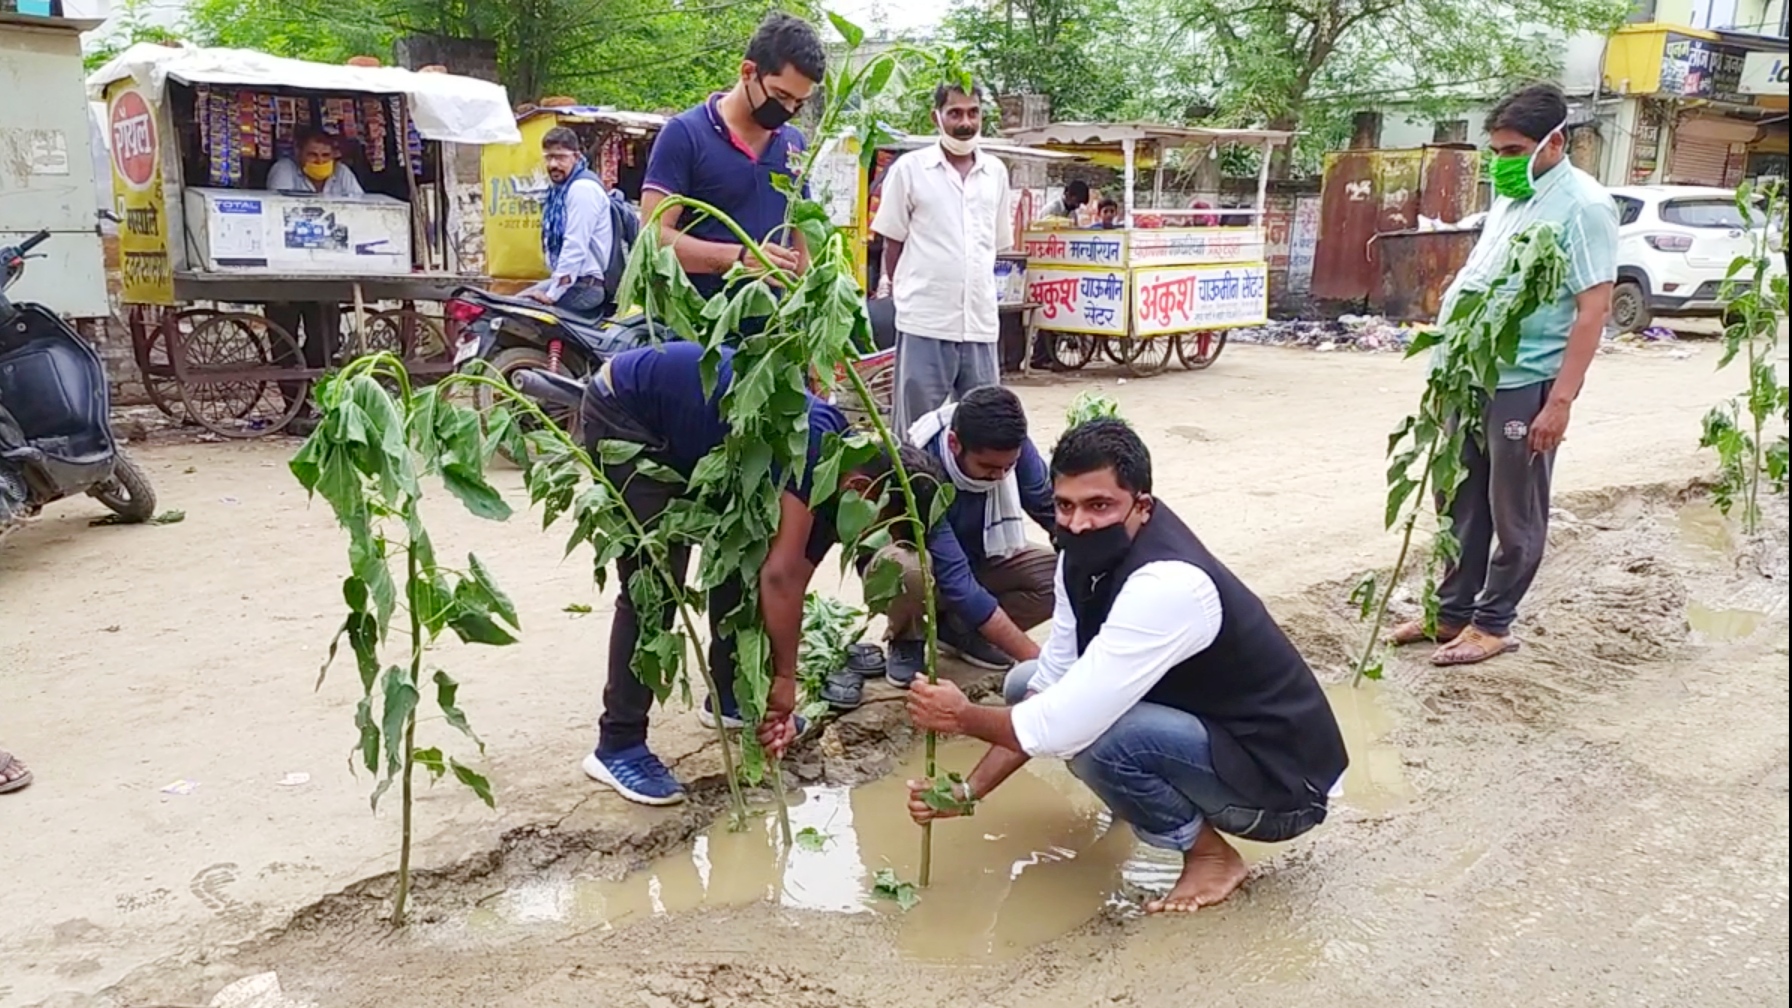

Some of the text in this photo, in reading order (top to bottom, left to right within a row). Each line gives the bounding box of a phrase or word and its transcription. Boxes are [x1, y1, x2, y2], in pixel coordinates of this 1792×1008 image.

[214, 200, 259, 210] TOTAL
[1029, 275, 1079, 319] अंकुश
[1140, 275, 1197, 327] अंकुश
